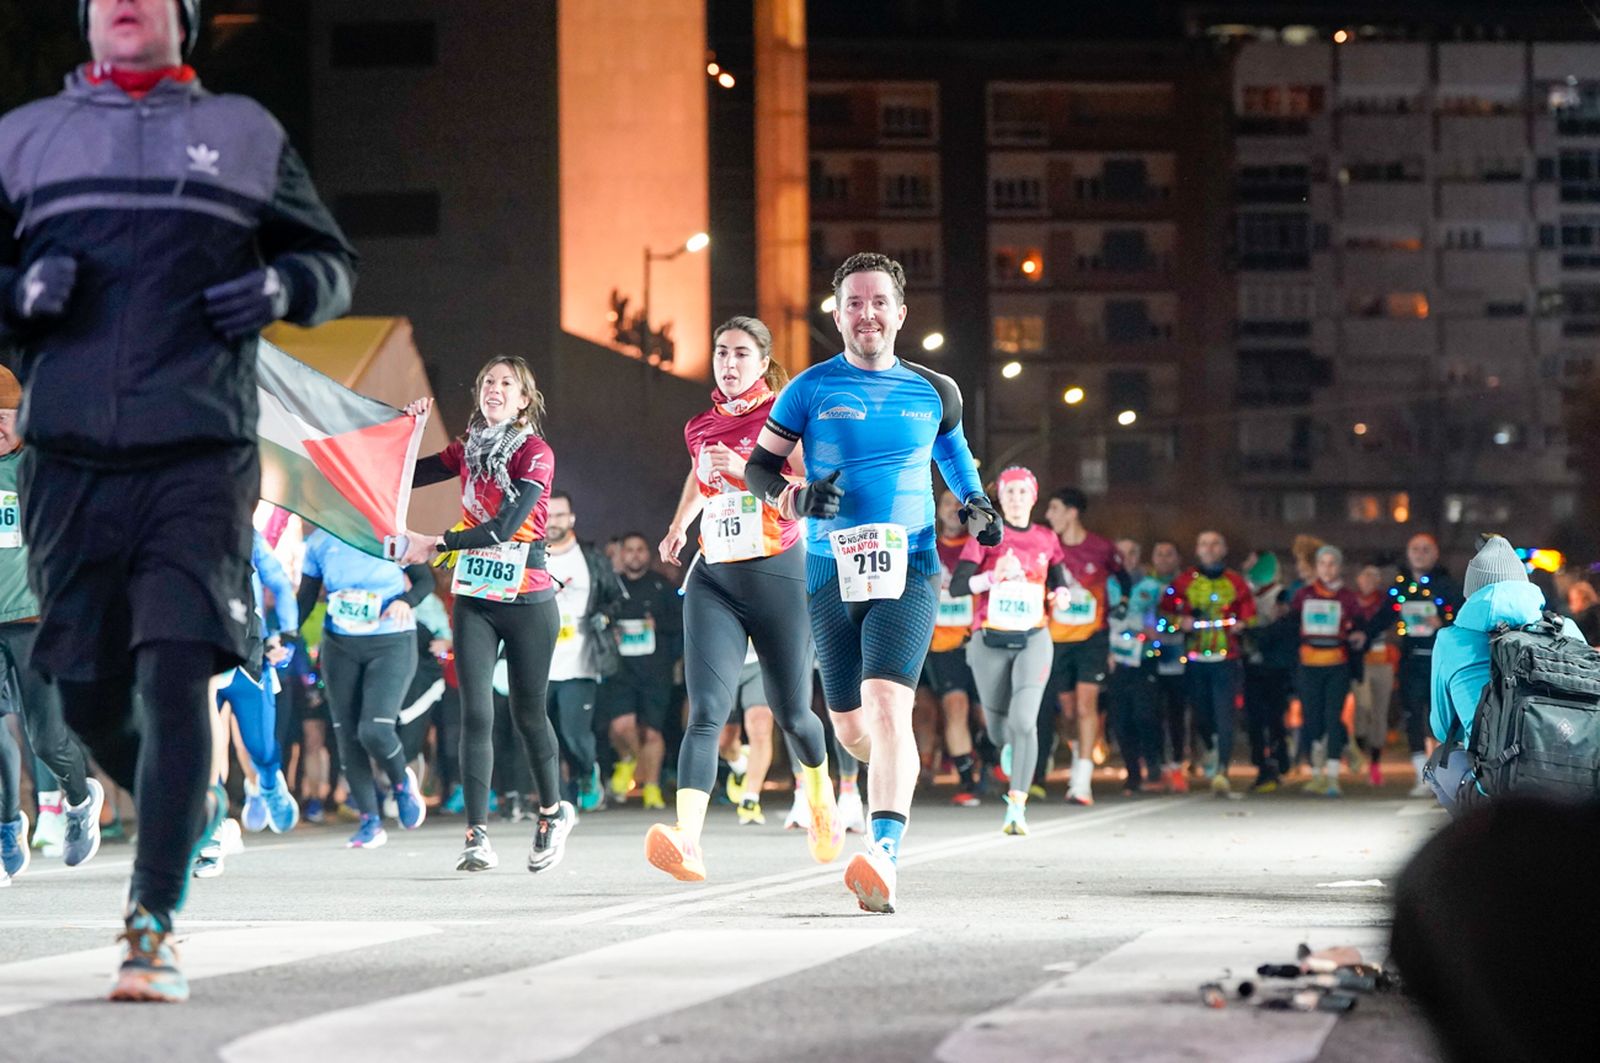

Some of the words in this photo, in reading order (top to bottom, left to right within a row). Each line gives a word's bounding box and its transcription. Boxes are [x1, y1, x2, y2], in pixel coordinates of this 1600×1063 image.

[0, 508, 15, 526] 6
[715, 516, 741, 538] 715
[841, 546, 856, 555] SAN
[466, 557, 515, 581] 13783
[853, 550, 892, 575] 219
